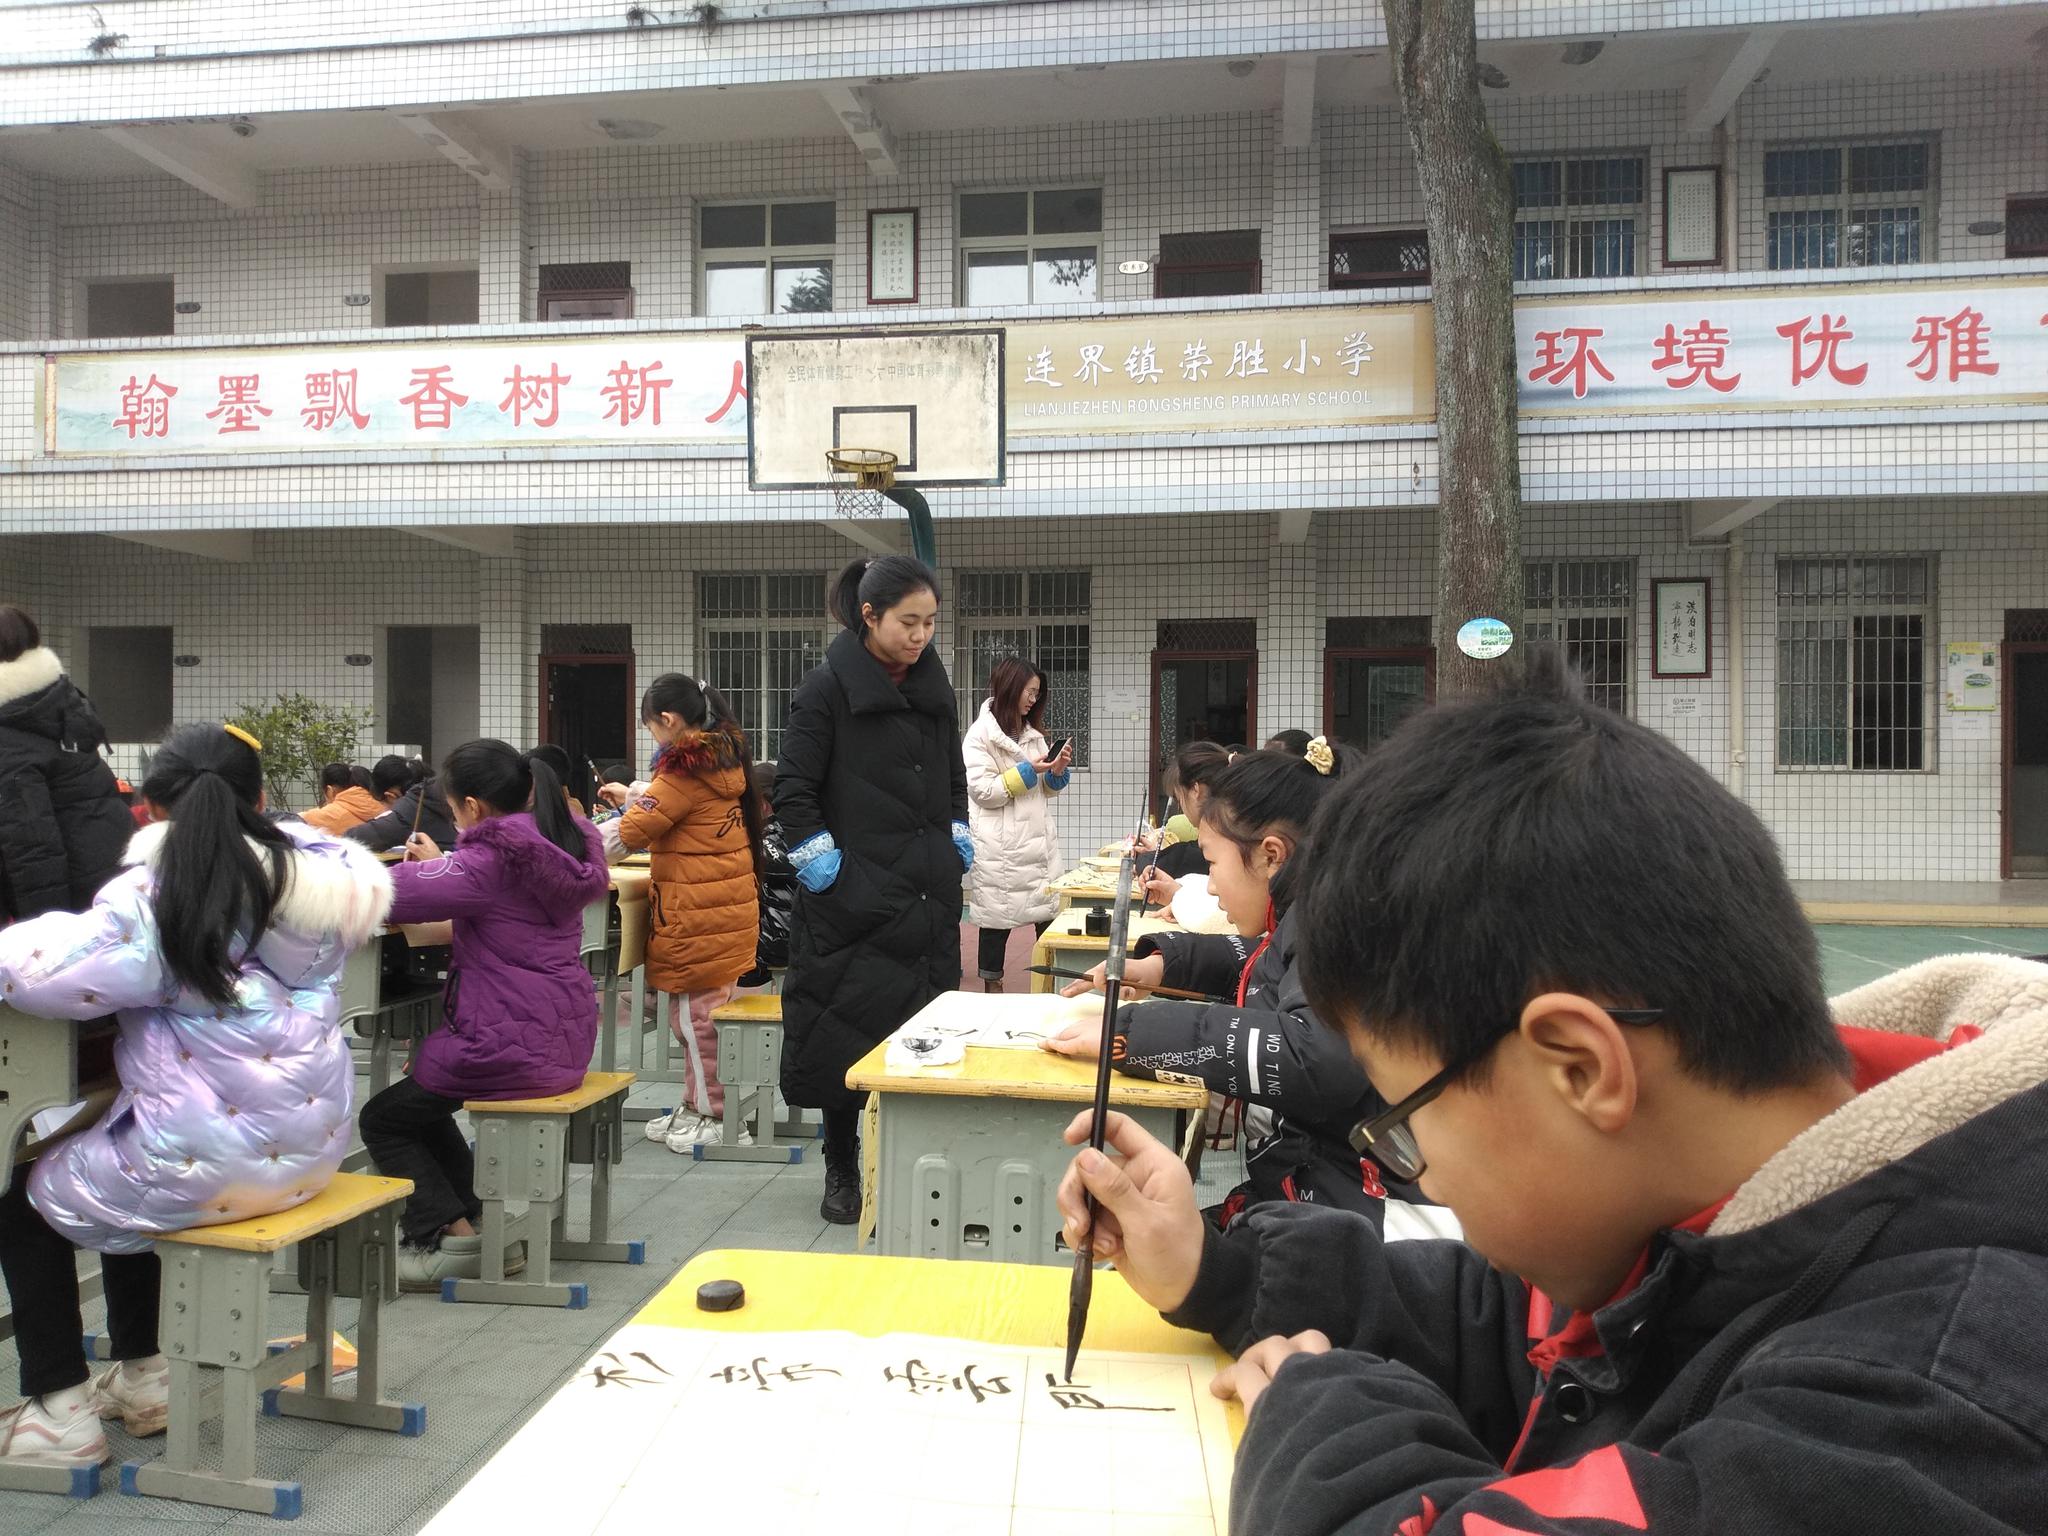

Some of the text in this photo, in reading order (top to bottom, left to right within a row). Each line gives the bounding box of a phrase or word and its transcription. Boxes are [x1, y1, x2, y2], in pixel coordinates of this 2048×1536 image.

[1024, 330, 1375, 387] 连界镇荣胜小学
[1527, 305, 2048, 399] 环境优雅
[1024, 389, 1372, 417] LIANJIEZHEN RONGSHENG PRIMARY SCHOOL
